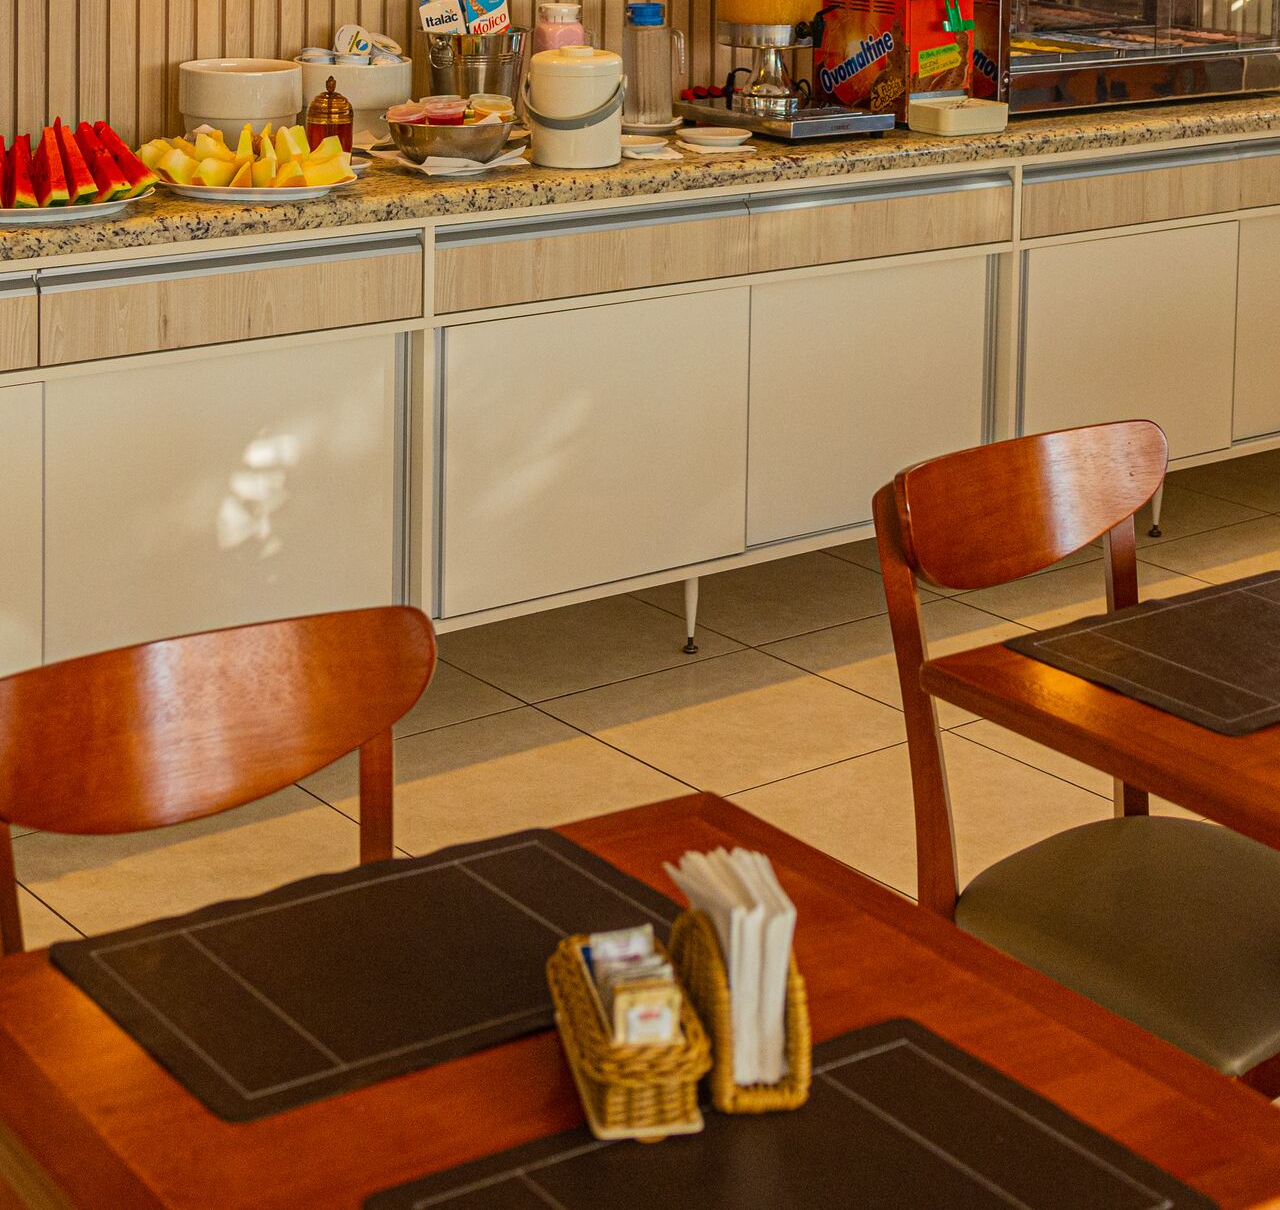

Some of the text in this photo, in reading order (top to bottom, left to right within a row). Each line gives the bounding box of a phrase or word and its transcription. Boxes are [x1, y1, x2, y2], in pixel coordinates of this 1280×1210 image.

[425, 12, 458, 28] Italac
[473, 13, 507, 34] Molico
[820, 31, 895, 94] Ovomaltine
